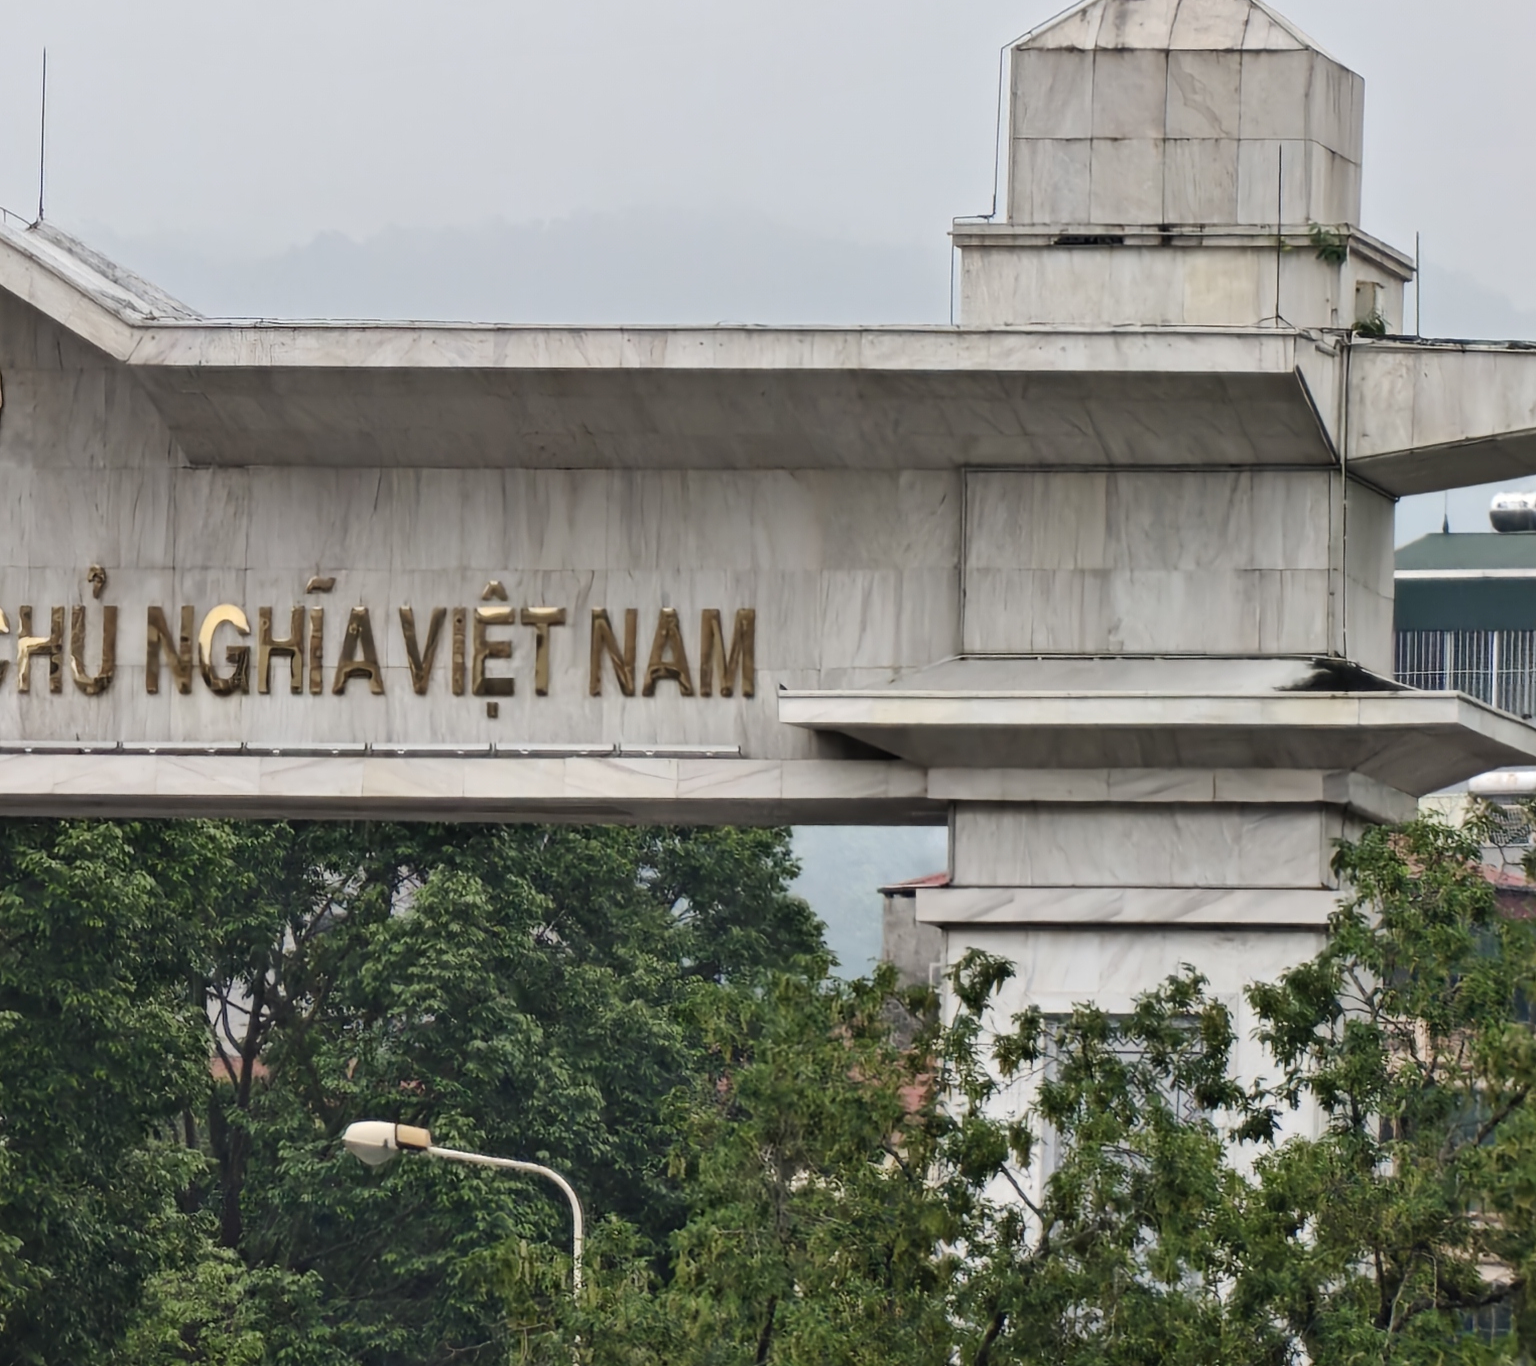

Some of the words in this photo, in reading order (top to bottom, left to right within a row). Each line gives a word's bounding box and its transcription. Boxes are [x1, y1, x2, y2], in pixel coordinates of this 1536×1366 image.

[147, 576, 385, 697] NGHĨA
[399, 580, 567, 719] VIỆT
[589, 607, 756, 699] NAM
